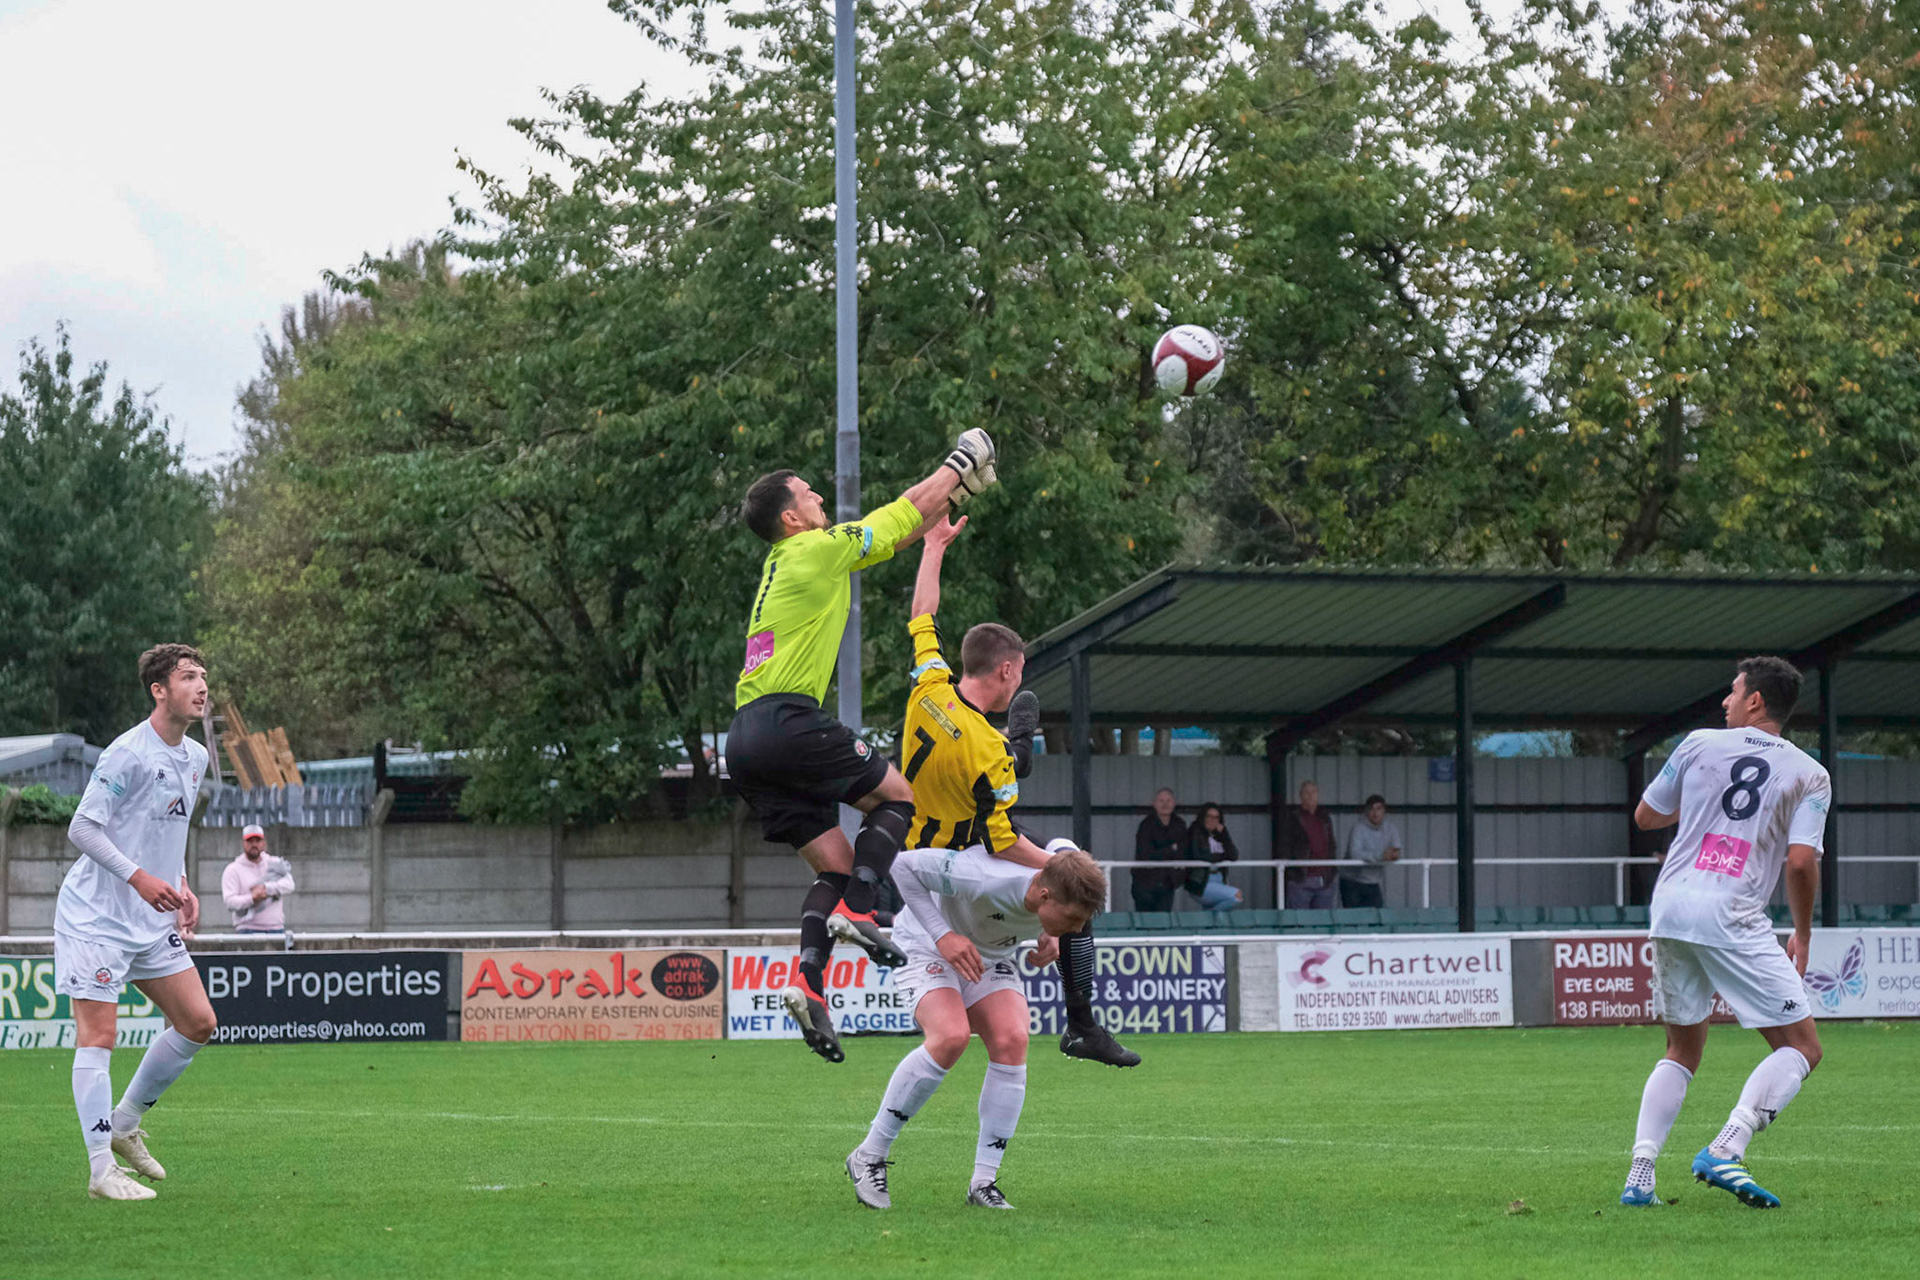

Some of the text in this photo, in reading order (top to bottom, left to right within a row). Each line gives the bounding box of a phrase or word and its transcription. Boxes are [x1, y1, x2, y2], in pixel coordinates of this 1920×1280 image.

[904, 725, 937, 784] 7
[1722, 756, 1771, 821] 8
[1699, 849, 1743, 872] HOME
[168, 933, 182, 948] 6
[1091, 946, 1193, 976] ROWN
[1344, 948, 1503, 975] Chartwell
[1555, 942, 1634, 969] RABIN
[208, 964, 441, 1004] BP Properties
[466, 951, 647, 1000] Adrak
[1349, 977, 1476, 988] WEALTH MANAGEMENT
[1564, 977, 1634, 993] EYE CARE
[1105, 979, 1121, 1001] &
[1126, 978, 1226, 1001] JOINERY
[1295, 988, 1500, 1009] INDEPENDENT FINANCIAL ADVISERS
[464, 1004, 720, 1020] CONTEMPORARY EASTERN CUISINE
[1294, 1008, 1500, 1028] TEL: 0161 929 3500 www.chartwellfs.com
[1559, 1002, 1588, 1019] 138
[1592, 1000, 1641, 1018] Flixton
[465, 1025, 487, 1041] 96
[494, 1025, 577, 1041] FLIXTON
[583, 1025, 611, 1041] RD
[634, 1024, 666, 1040] 748
[675, 1023, 714, 1040] 7614
[731, 1015, 775, 1031] WET
[841, 1013, 920, 1030] AGGRE
[0, 1024, 46, 1048] For
